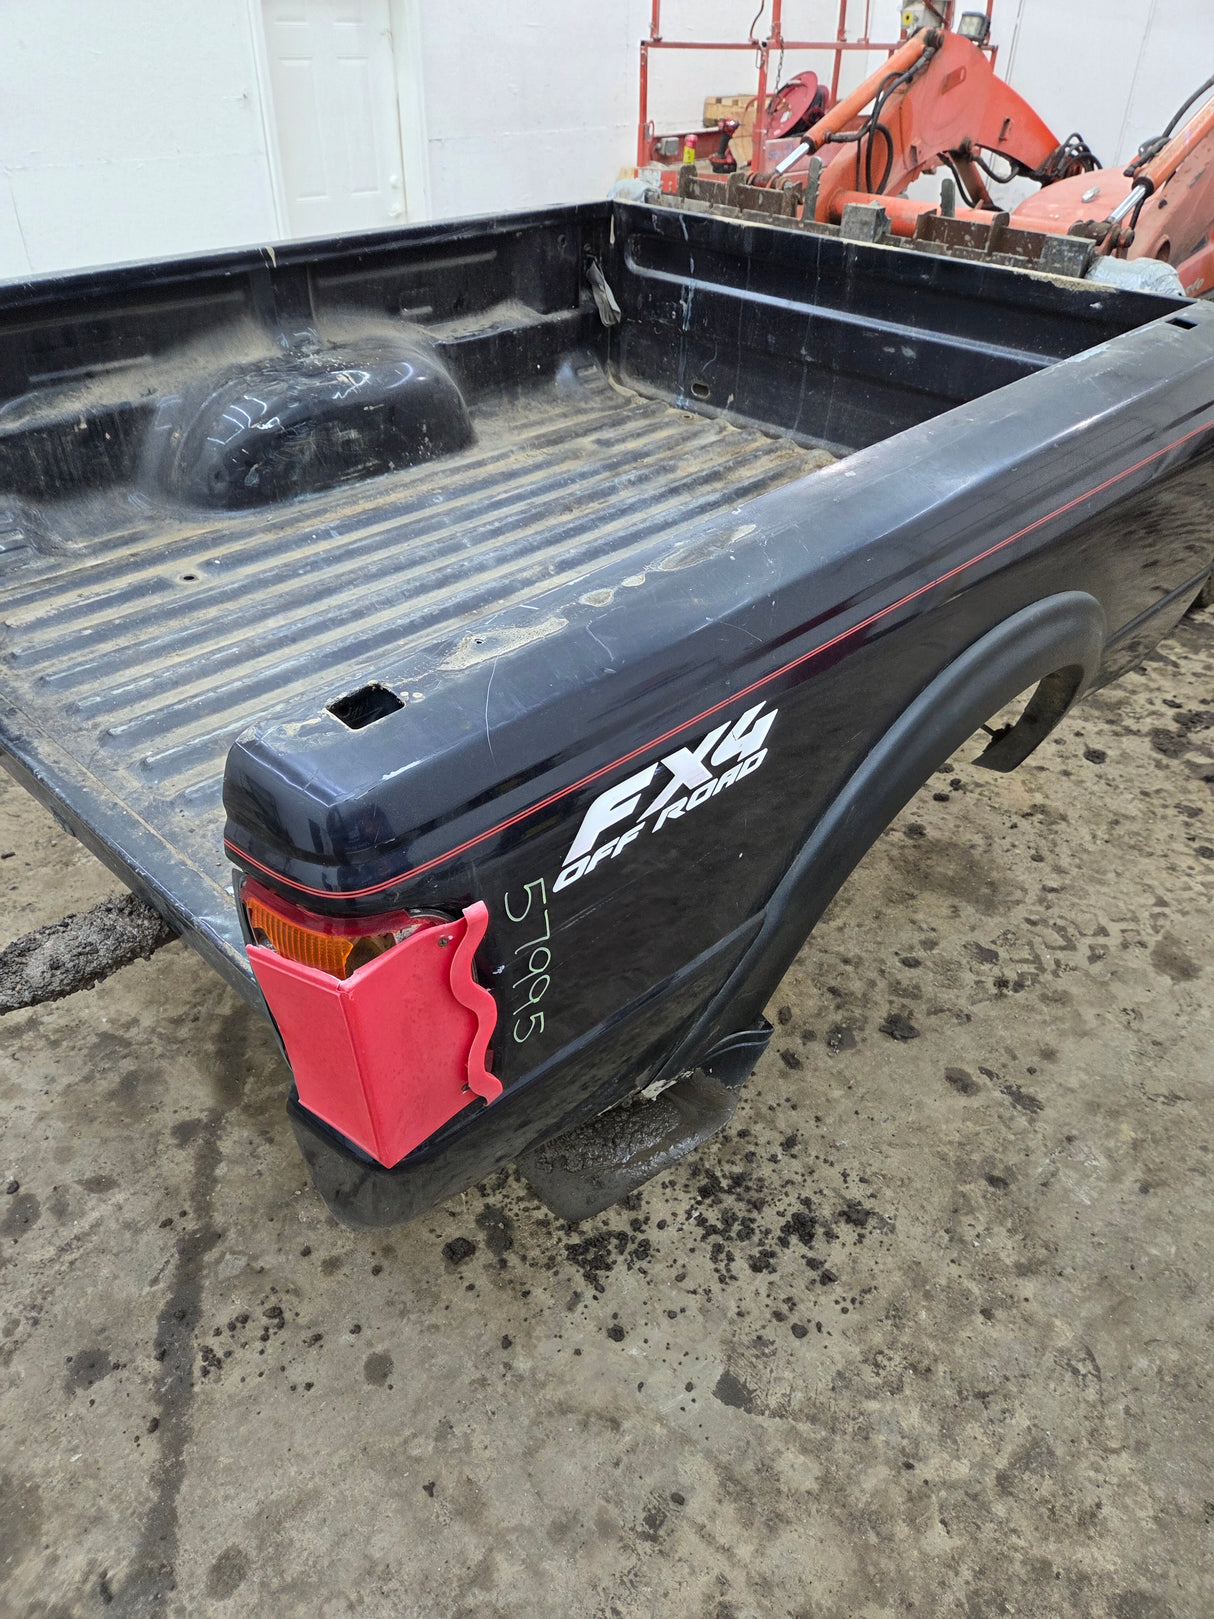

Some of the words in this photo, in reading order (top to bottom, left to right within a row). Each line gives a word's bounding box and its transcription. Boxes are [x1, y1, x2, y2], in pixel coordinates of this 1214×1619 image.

[553, 821, 646, 893] OFF
[652, 748, 768, 833] ROAD
[562, 701, 778, 867] FX4
[504, 877, 551, 1043] 57995
